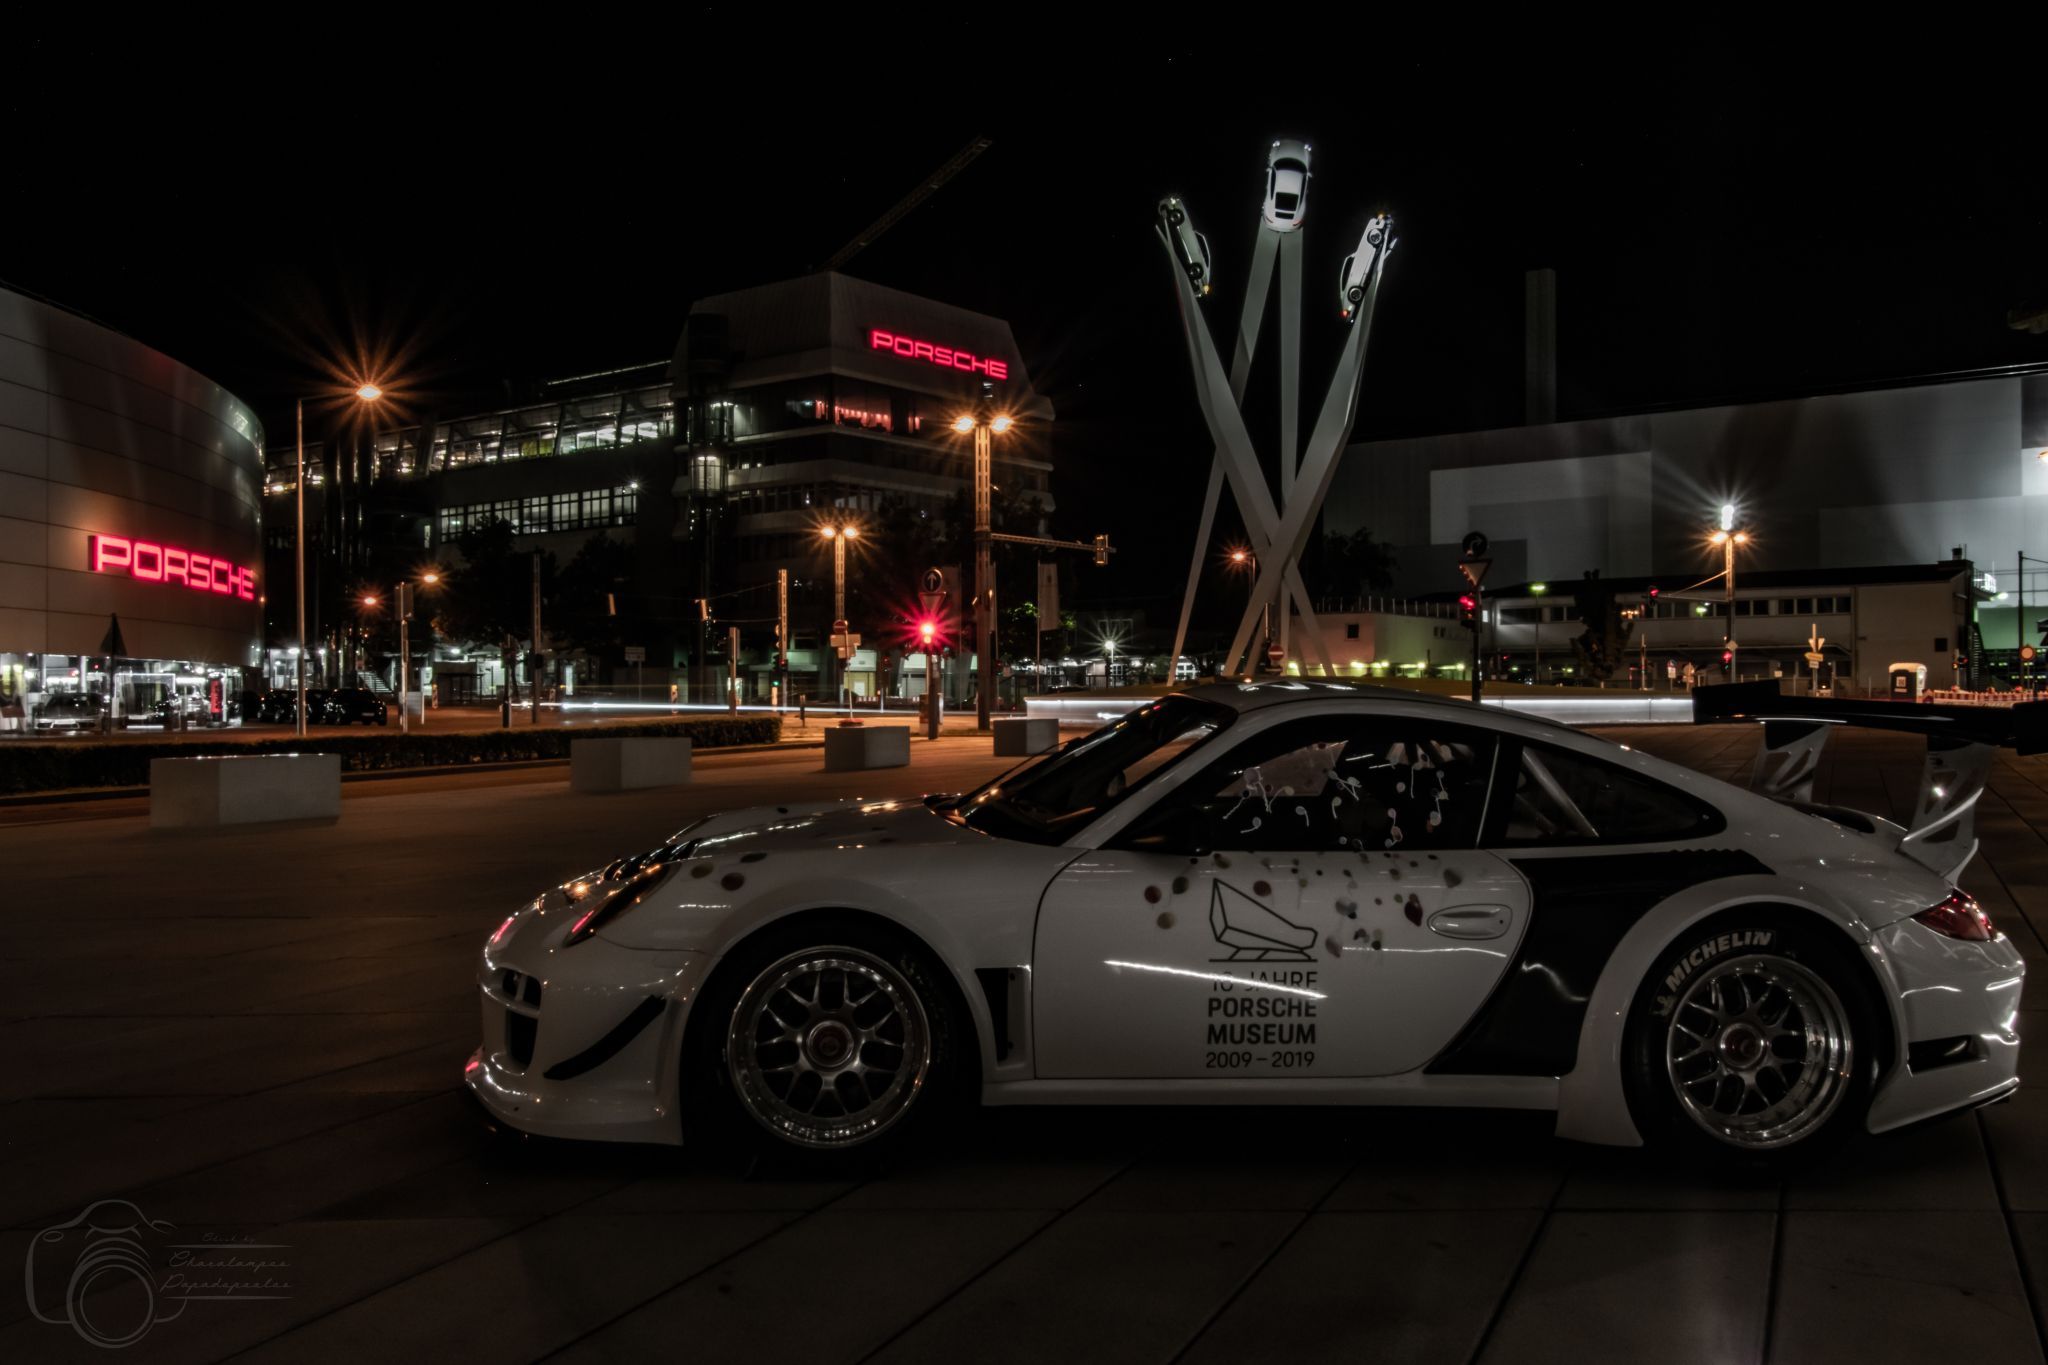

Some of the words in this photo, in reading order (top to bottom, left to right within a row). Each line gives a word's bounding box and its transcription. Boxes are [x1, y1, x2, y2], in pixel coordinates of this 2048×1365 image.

[870, 329, 1008, 380] PORSCHE
[94, 534, 255, 600] PORSCHE
[1665, 931, 1772, 992] MICHELIN
[1244, 971, 1318, 992] JAHRE
[1208, 997, 1317, 1018] PORSCHE
[1207, 1023, 1316, 1044] MUSEUM
